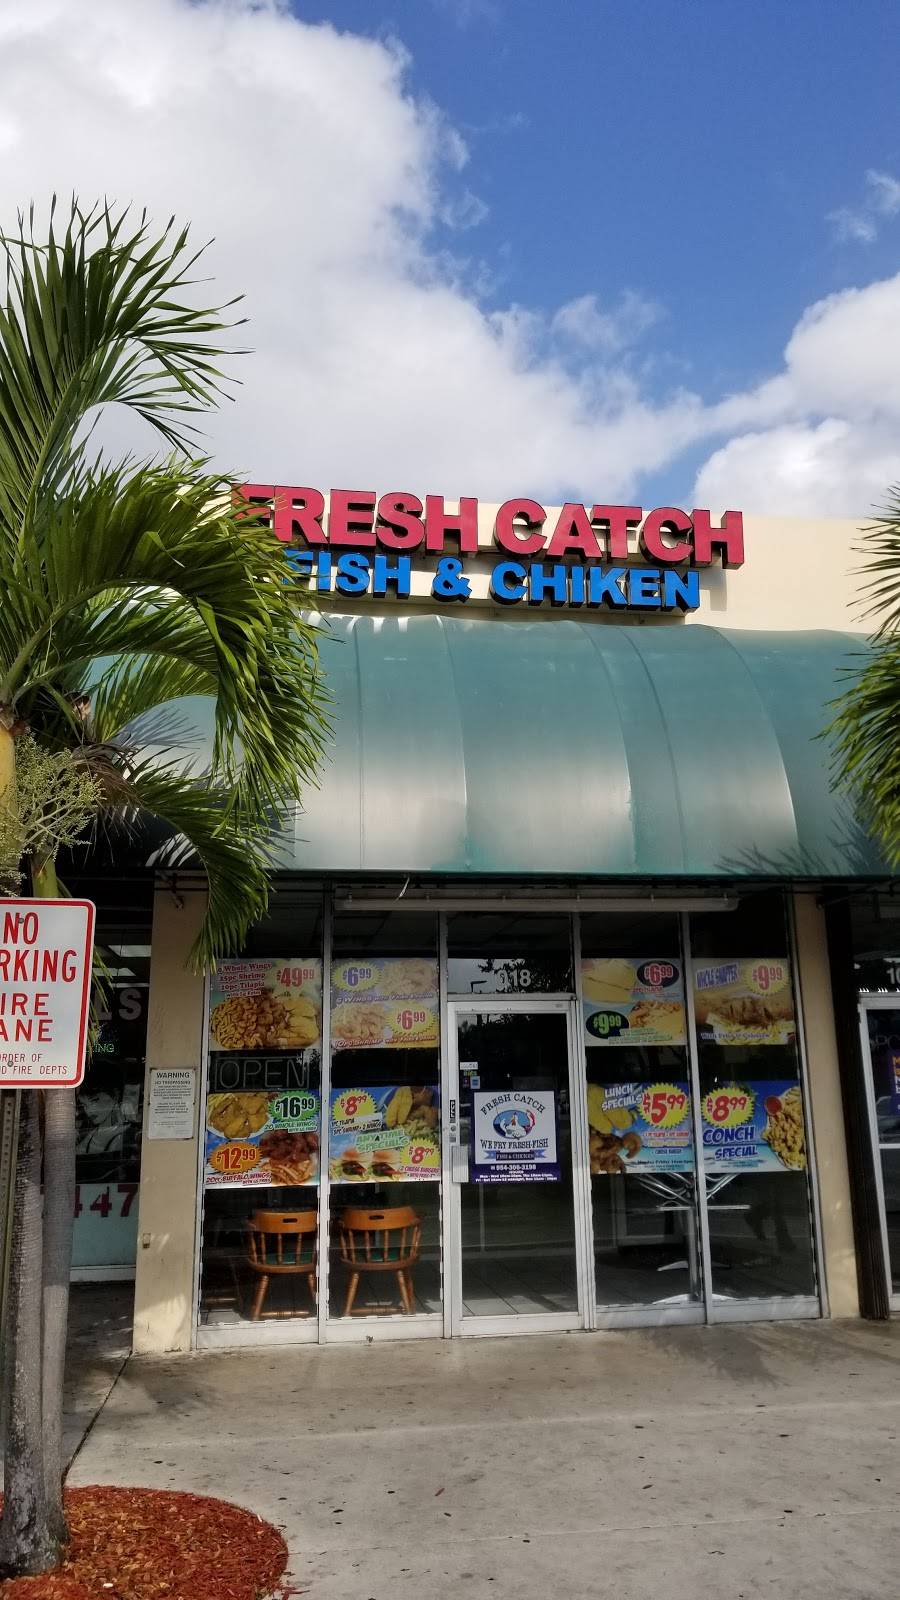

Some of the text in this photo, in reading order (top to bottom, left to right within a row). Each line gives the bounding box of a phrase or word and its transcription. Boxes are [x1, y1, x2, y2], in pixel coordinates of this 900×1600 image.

[232, 484, 744, 567] FRESH CATCH
[284, 549, 701, 609] FISH & CHIKEN
[3, 912, 39, 945] NO
[239, 972, 265, 981] Shrimp
[240, 982, 265, 991] Tilapia
[0, 1053, 43, 1063] RDER OF
[13, 1065, 33, 1075] FIRE
[39, 1066, 68, 1075] DEPTS
[220, 1060, 305, 1088] OPEN
[604, 1084, 633, 1098] LUNCH
[480, 1093, 511, 1115] FRESH
[514, 1093, 546, 1114] CATCH
[601, 1094, 643, 1111] SPECIALS
[703, 1127, 754, 1144] CONCH
[480, 1139, 493, 1150] WE
[493, 1140, 506, 1149] FRY
[714, 1146, 759, 1161] SPECIAL
